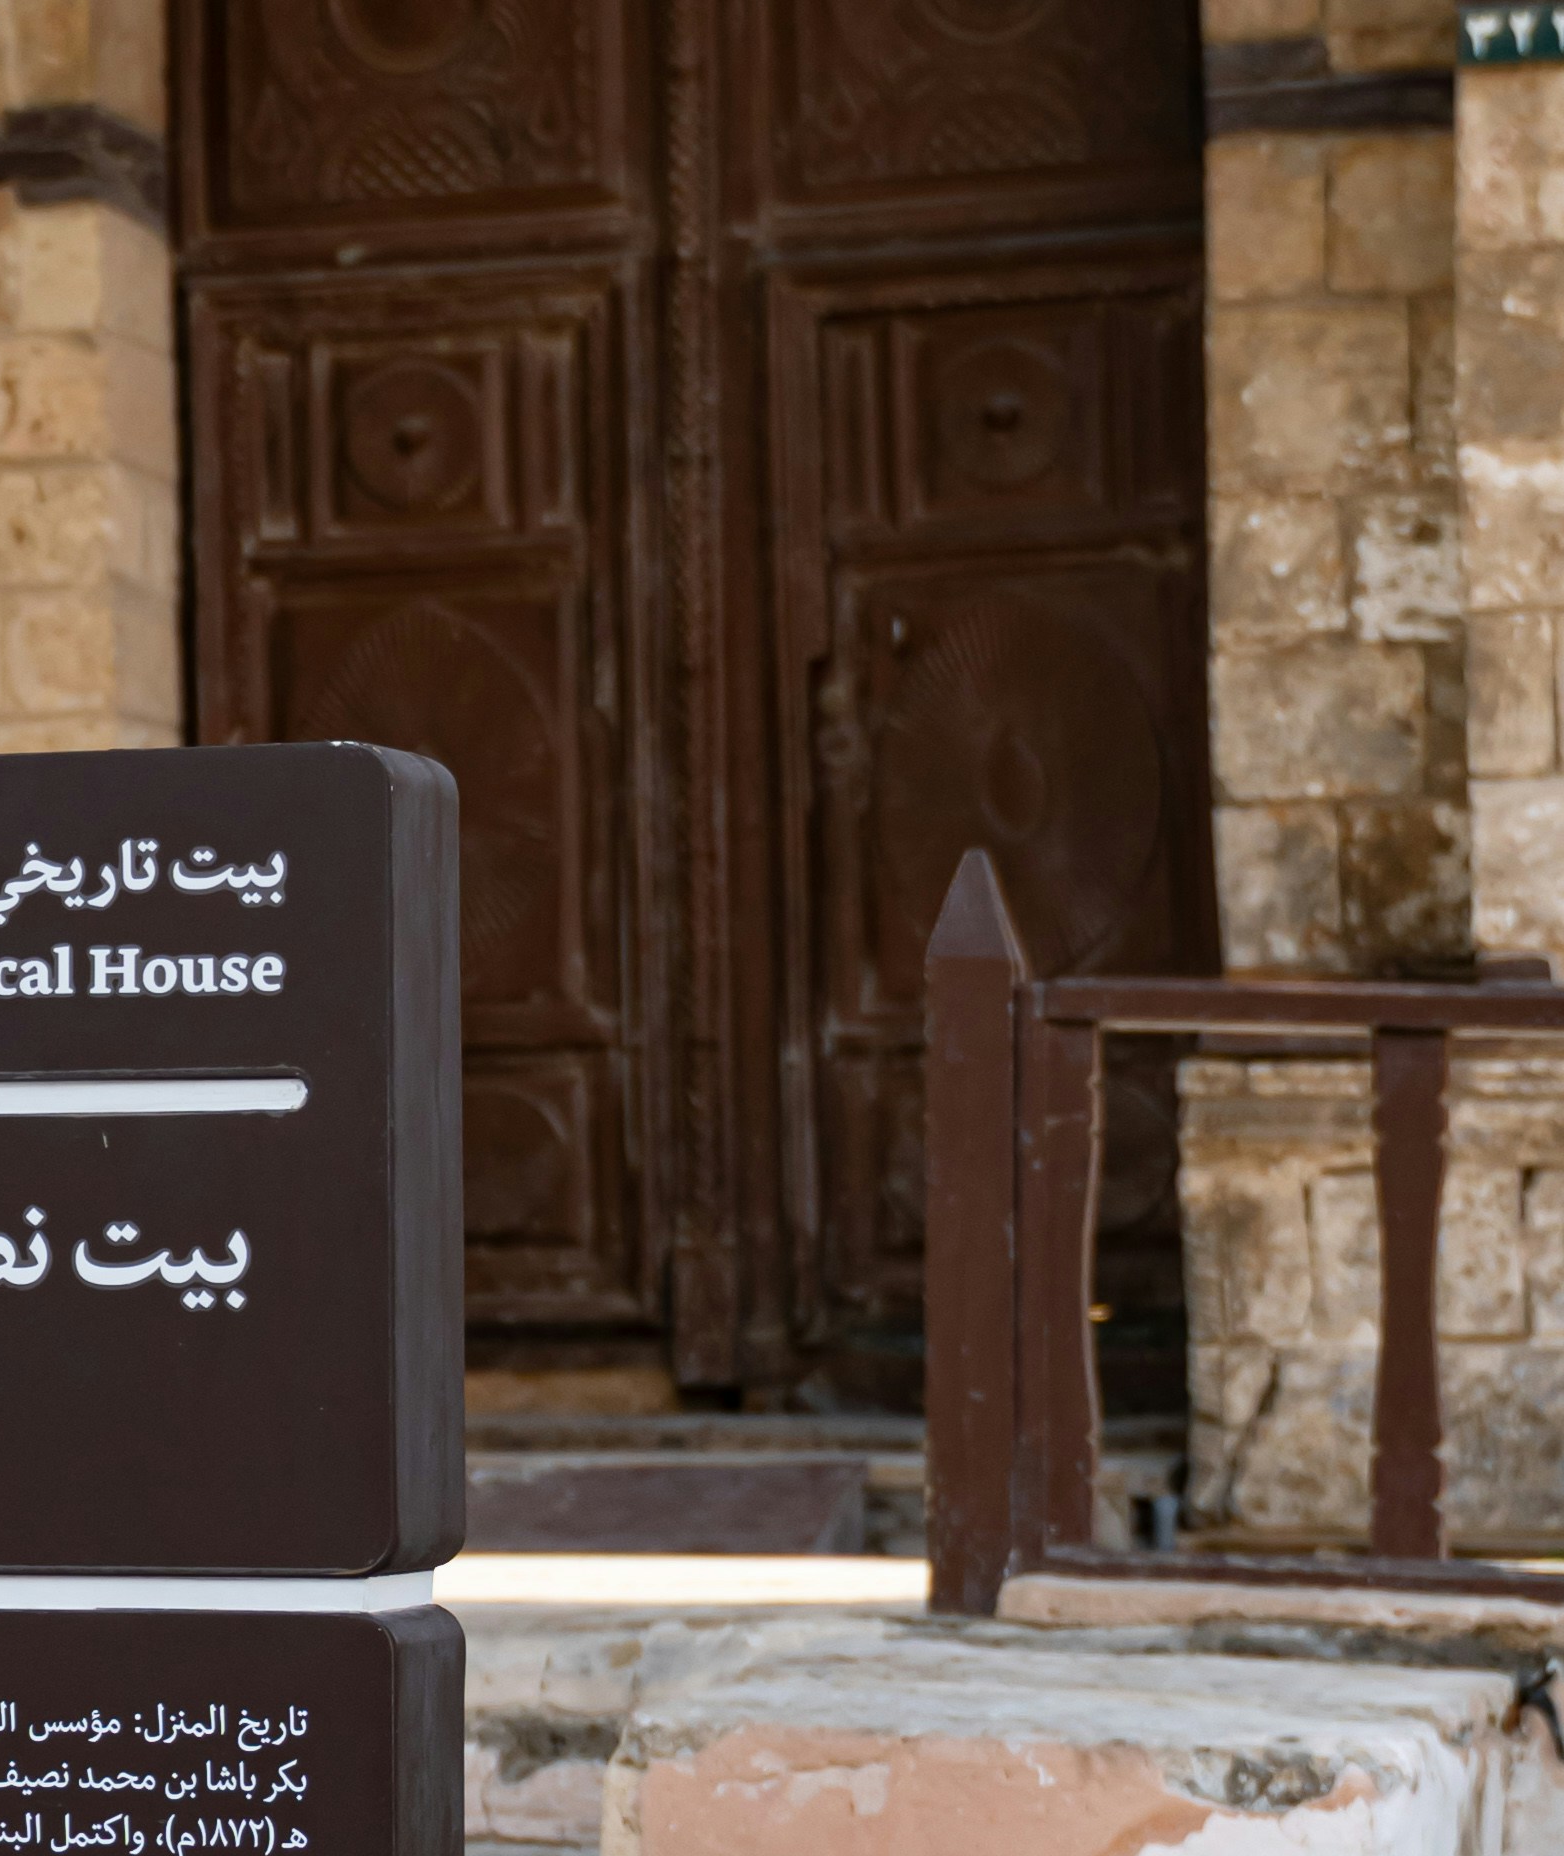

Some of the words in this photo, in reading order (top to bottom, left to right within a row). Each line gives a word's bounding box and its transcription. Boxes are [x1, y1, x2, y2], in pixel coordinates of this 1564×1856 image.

[172, 849, 285, 904] بيت
[88, 947, 284, 995] House
[75, 1223, 248, 1309] بيت
[28, 1708, 122, 1743] مؤسس
[134, 1702, 226, 1745] المنزل:
[237, 1704, 309, 1753] تاريخ
[78, 1766, 157, 1793] محمد
[164, 1771, 198, 1801] بن
[205, 1759, 257, 1801] باشا
[262, 1757, 308, 1804] بكر
